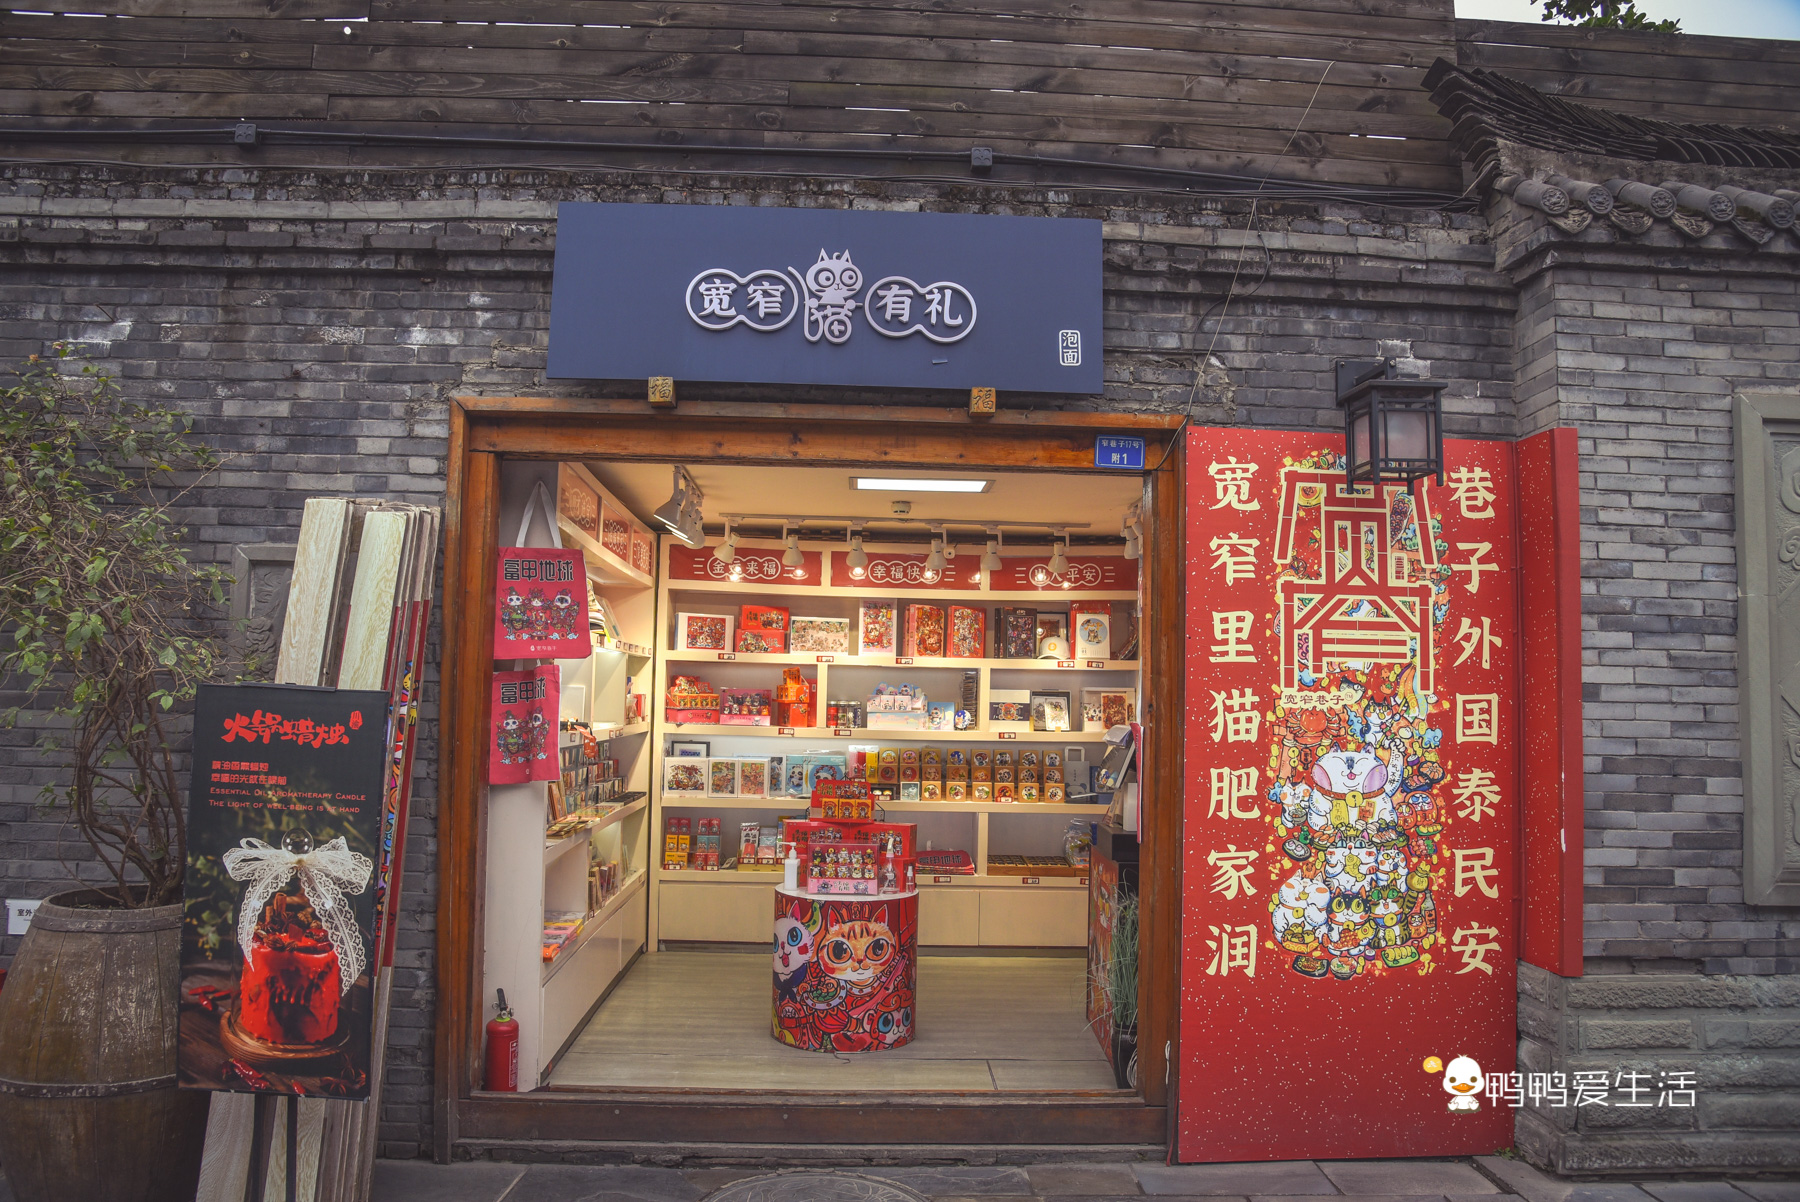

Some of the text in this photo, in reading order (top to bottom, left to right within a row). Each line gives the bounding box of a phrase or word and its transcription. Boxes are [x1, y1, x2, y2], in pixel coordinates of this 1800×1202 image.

[1062, 331, 1078, 363] 泡面
[1101, 439, 1140, 449] 窄巷子17号
[1111, 453, 1127, 465] 附1
[1283, 694, 1345, 706] 宽窄巷子
[1207, 455, 1262, 978] 宽窄里猫肥家润
[1448, 466, 1502, 975] 巷子外国泰民安
[220, 709, 350, 749] 火锅蜡烛
[17, 908, 36, 917] 室外
